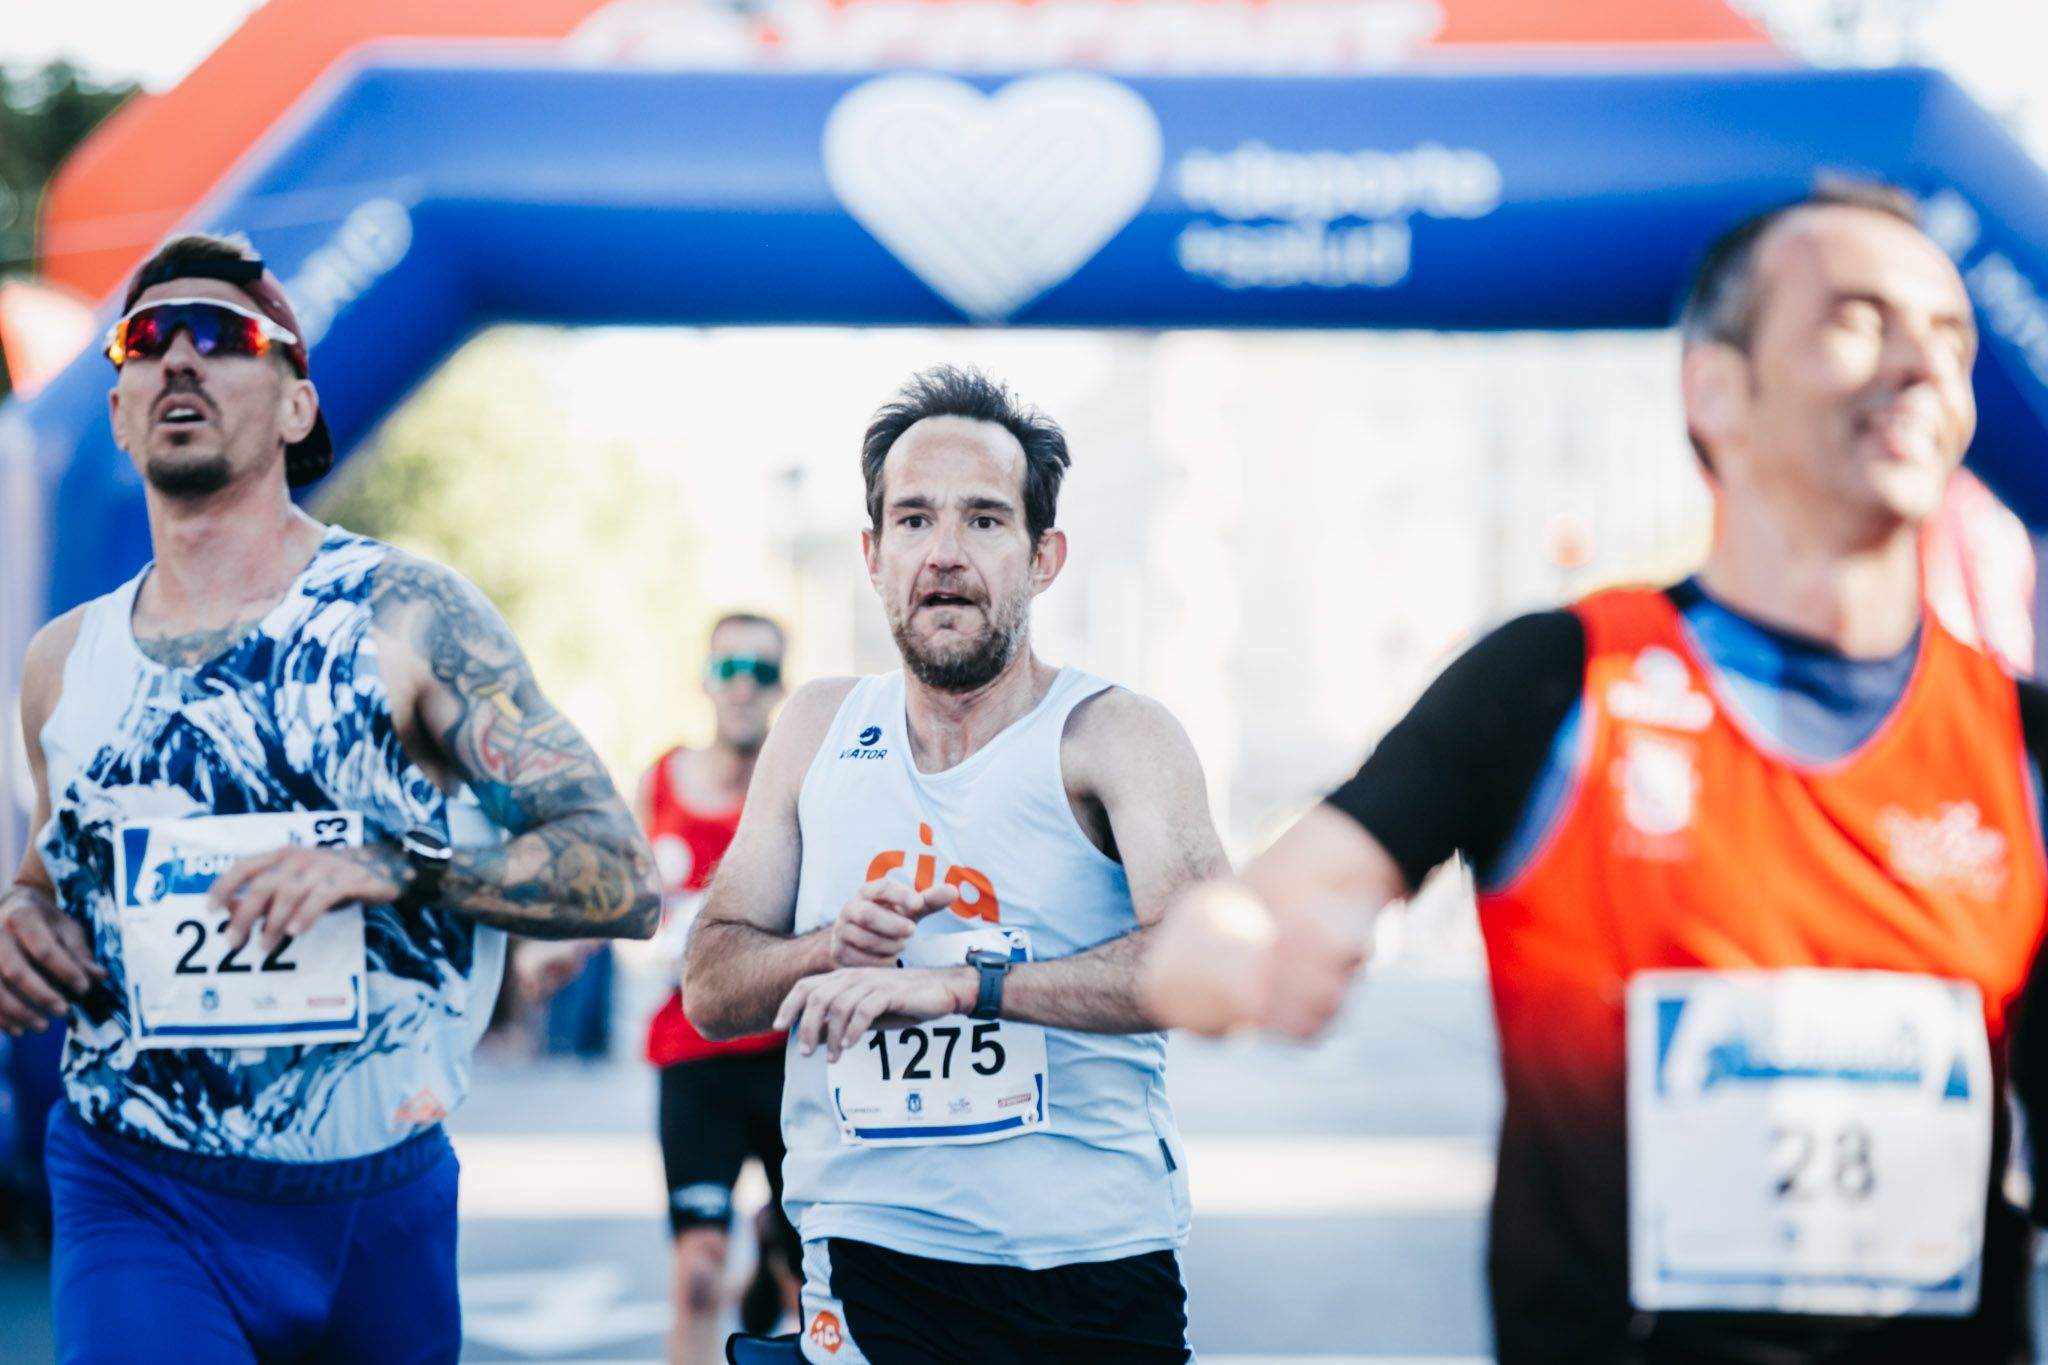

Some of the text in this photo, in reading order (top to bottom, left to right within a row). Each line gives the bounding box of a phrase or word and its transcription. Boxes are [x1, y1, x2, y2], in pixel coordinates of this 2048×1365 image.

[840, 748, 888, 760] VIATOR
[174, 920, 297, 974] 222
[868, 1021, 1006, 1081] 1275
[1769, 1124, 1875, 1203] 28
